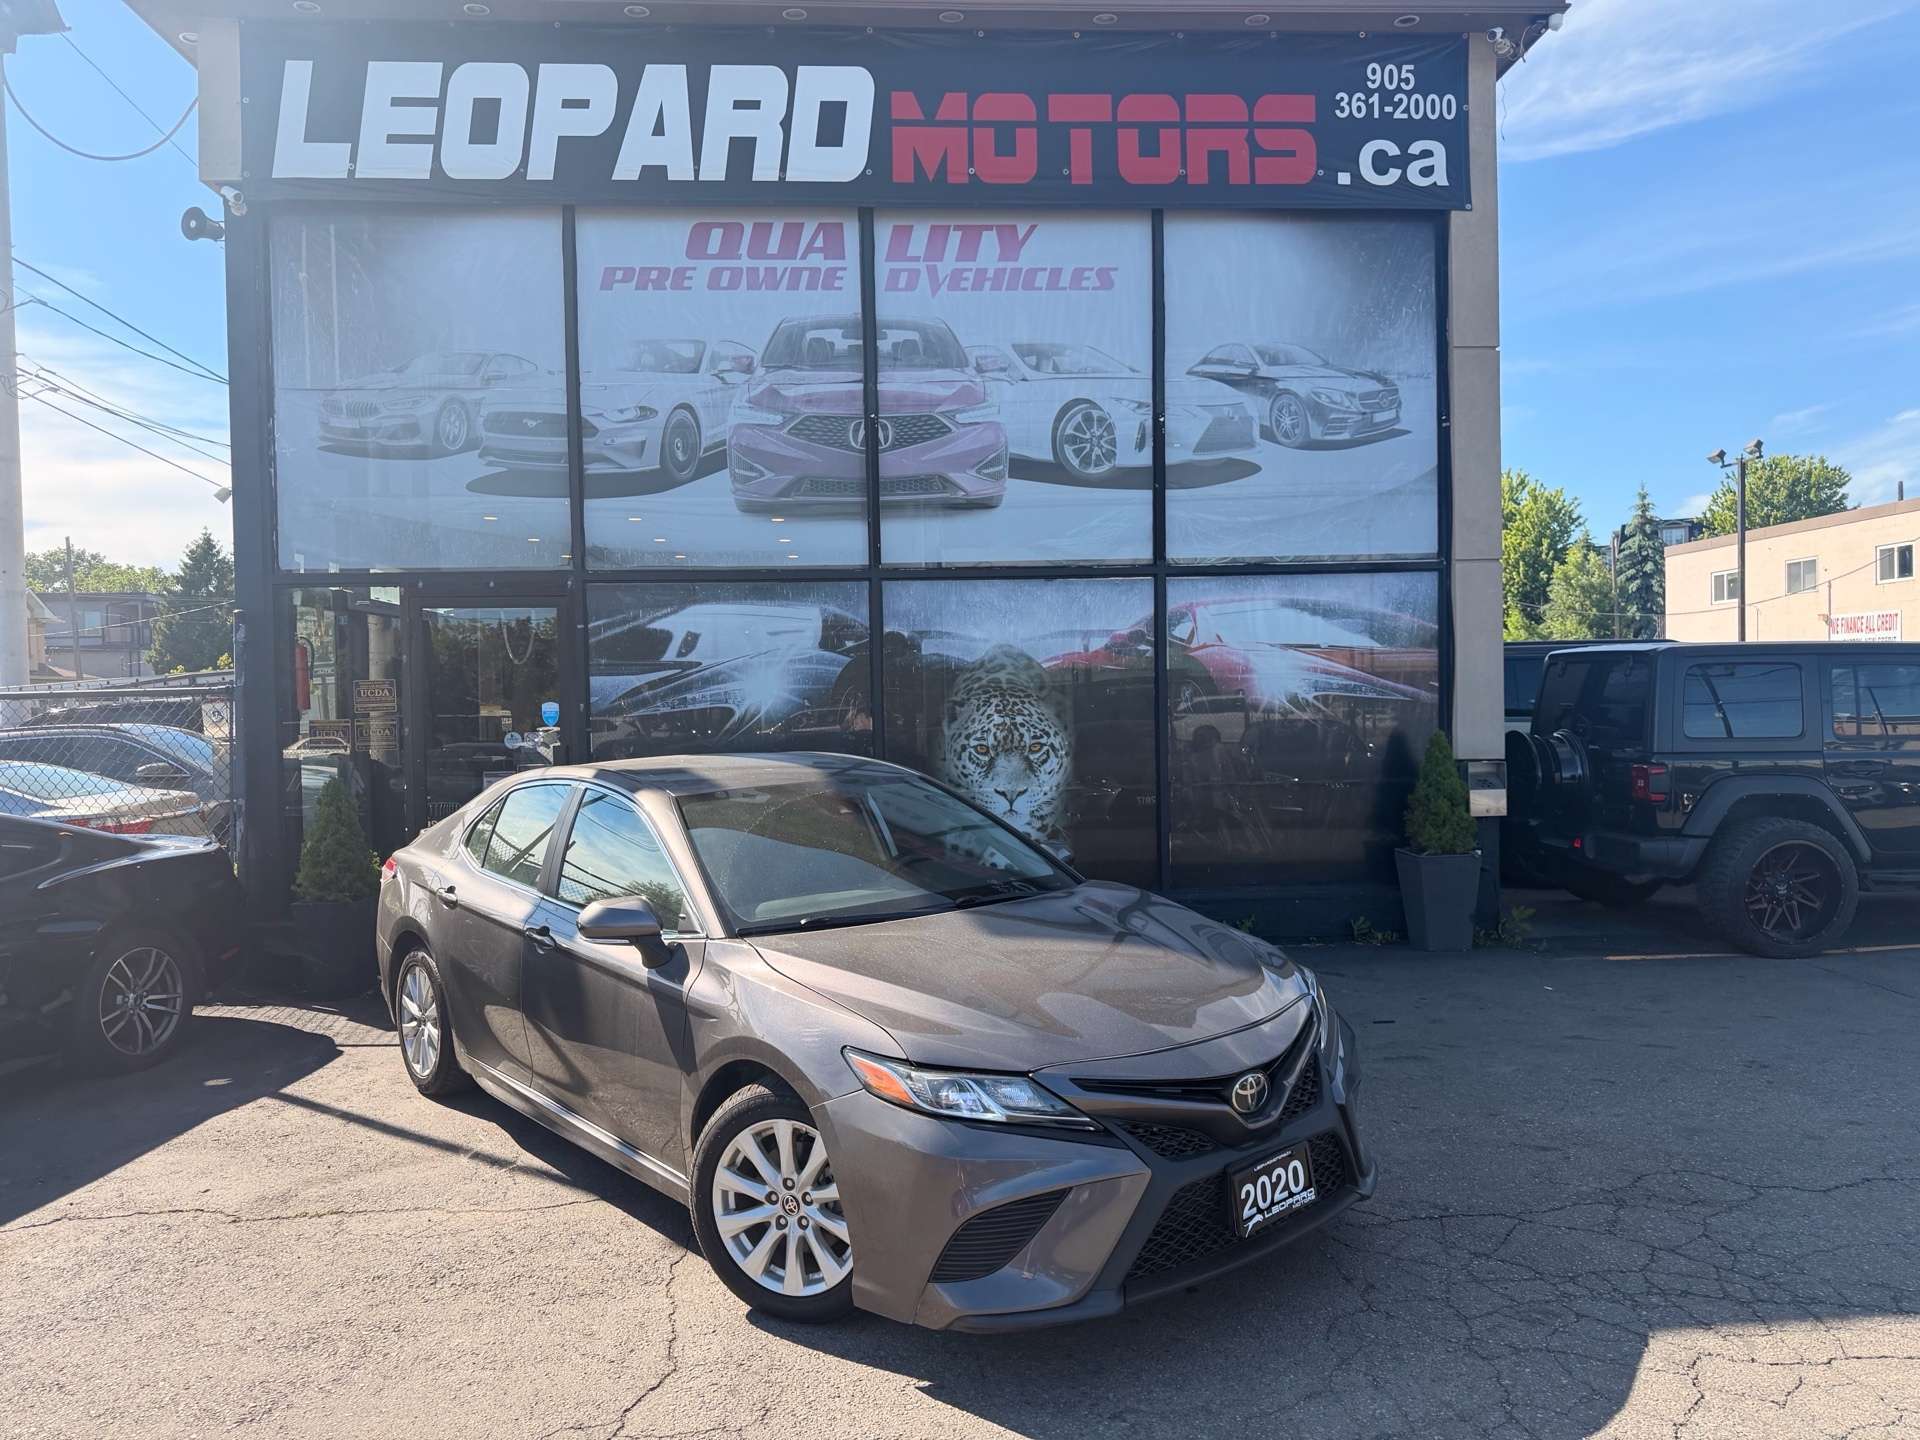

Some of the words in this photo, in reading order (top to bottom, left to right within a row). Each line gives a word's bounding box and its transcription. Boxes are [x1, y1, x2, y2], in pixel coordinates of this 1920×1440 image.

[1366, 62, 1416, 91] 905
[1335, 92, 1457, 120] 361-2000
[272, 60, 875, 182] LEOPARD
[891, 91, 1316, 185] MOTORS
[1337, 139, 1450, 187] .ca
[600, 266, 697, 291] PRE
[1841, 615, 1864, 634] FINANCE
[1865, 614, 1875, 634] ALL
[1877, 612, 1898, 632] CREDIT
[359, 689, 390, 697] UCDA
[1240, 1159, 1305, 1219] 2020
[1264, 1187, 1316, 1218] LEOPARD
